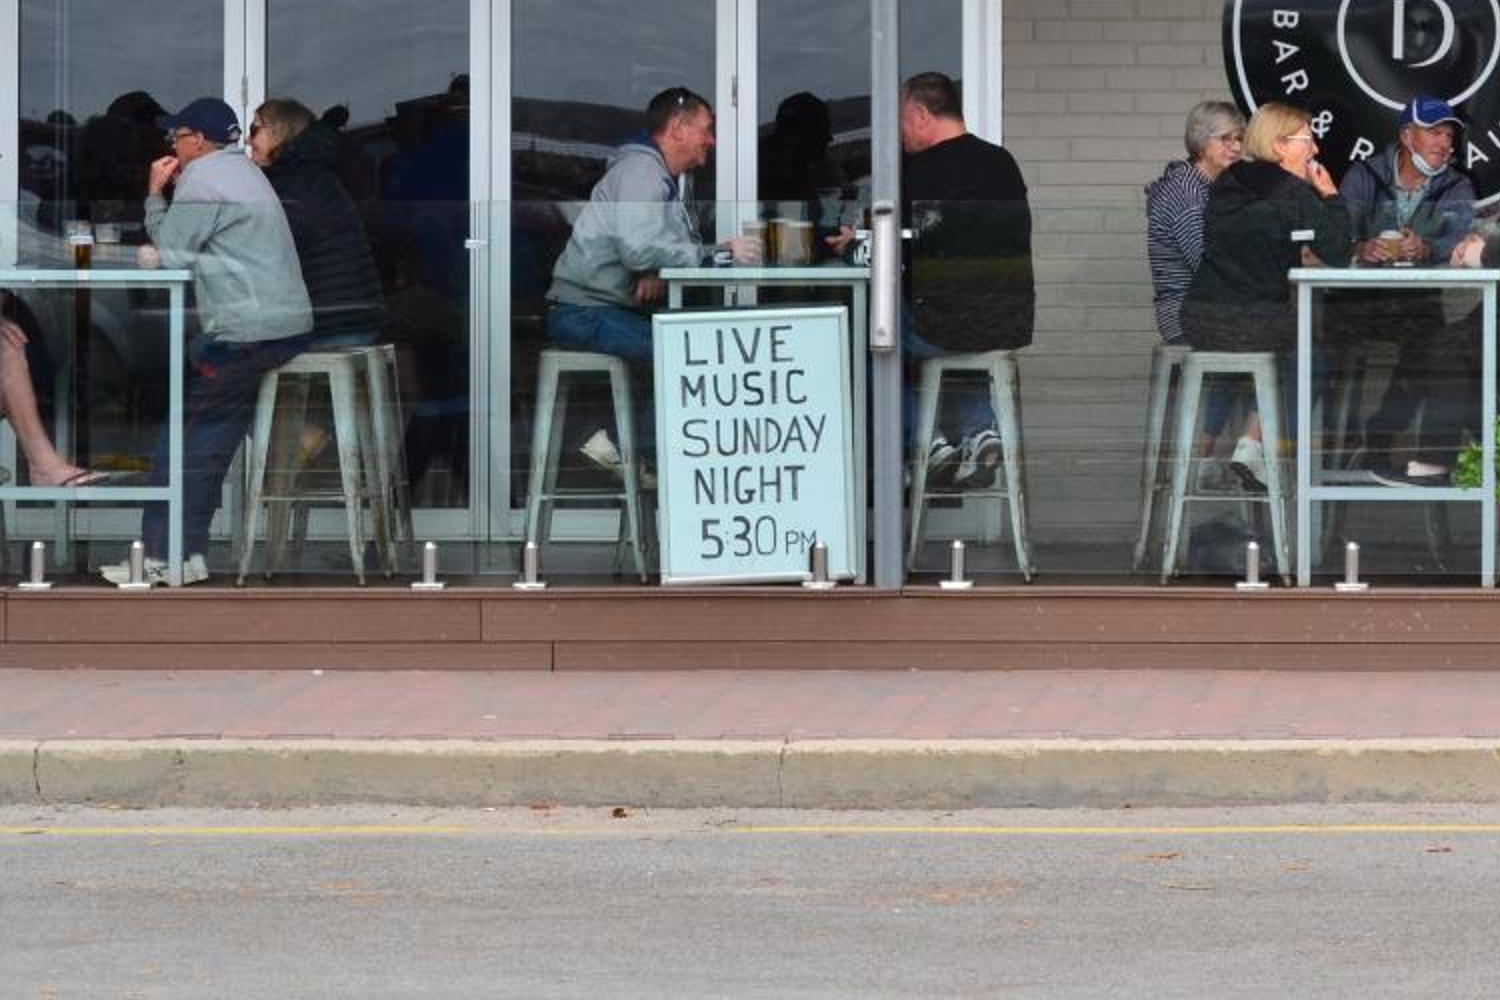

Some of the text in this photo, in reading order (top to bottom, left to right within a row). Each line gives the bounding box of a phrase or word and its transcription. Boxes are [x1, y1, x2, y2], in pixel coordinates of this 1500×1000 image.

[1272, 9, 1310, 95] BAR
[1311, 110, 1334, 139] &
[684, 325, 794, 366] LIVE
[681, 369, 807, 408] MUSIC
[682, 414, 826, 457] SUNDAY
[694, 465, 805, 505] NIGHT
[700, 515, 777, 559] 5:30
